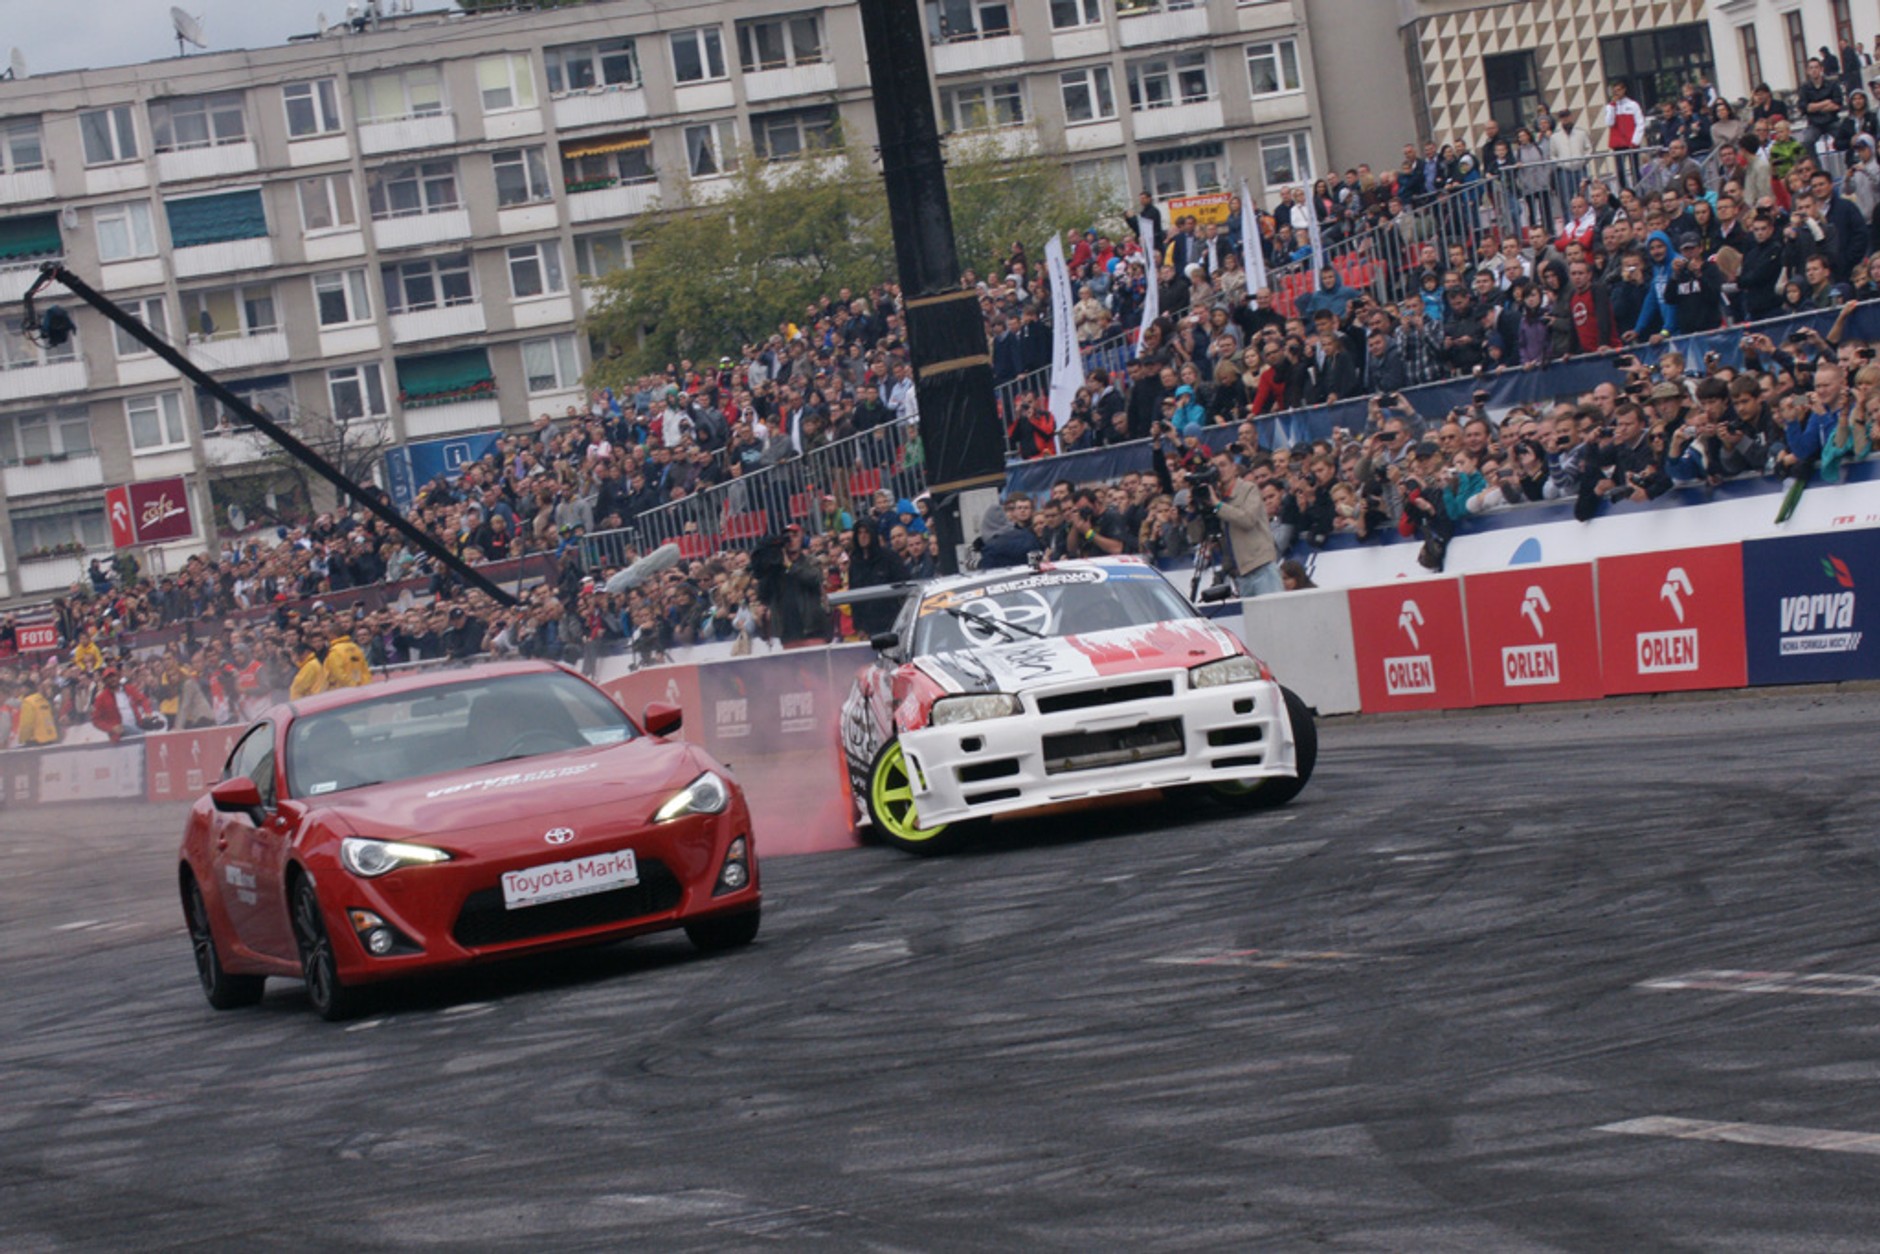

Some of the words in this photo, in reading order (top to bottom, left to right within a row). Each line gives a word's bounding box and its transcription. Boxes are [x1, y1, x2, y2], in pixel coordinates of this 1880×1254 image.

[1780, 591, 1855, 633] verva
[21, 630, 54, 645] FOTO
[1641, 635, 1694, 667] ORLEN
[1388, 661, 1431, 689] ORLEN
[1506, 651, 1555, 680] ORLEN
[506, 869, 573, 894] Toyota
[577, 854, 633, 879] Marki
